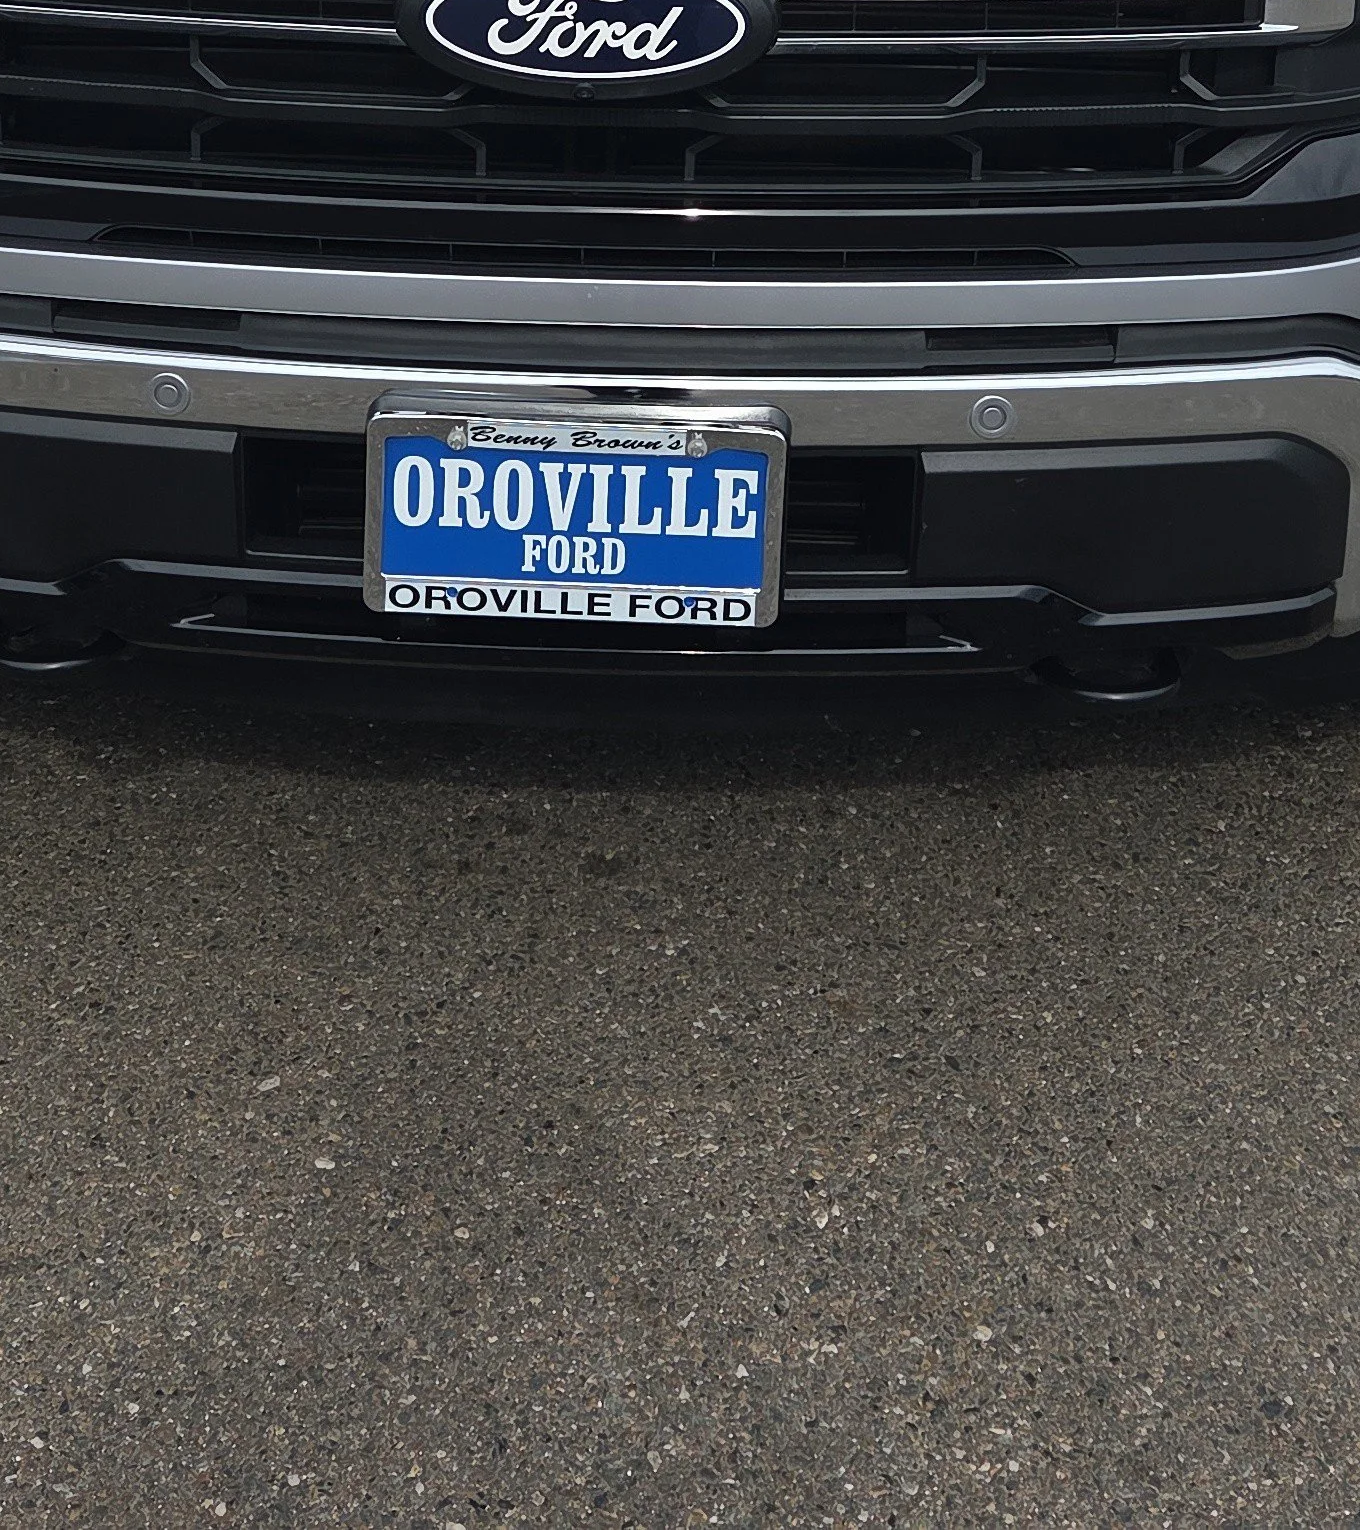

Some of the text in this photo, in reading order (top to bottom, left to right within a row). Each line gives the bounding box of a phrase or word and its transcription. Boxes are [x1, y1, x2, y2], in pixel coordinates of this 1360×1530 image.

[469, 425, 684, 451] Benny Brown's
[393, 455, 759, 539] OROVILLE
[521, 534, 626, 575] FORD
[388, 583, 753, 623] OROVILLE FORD
